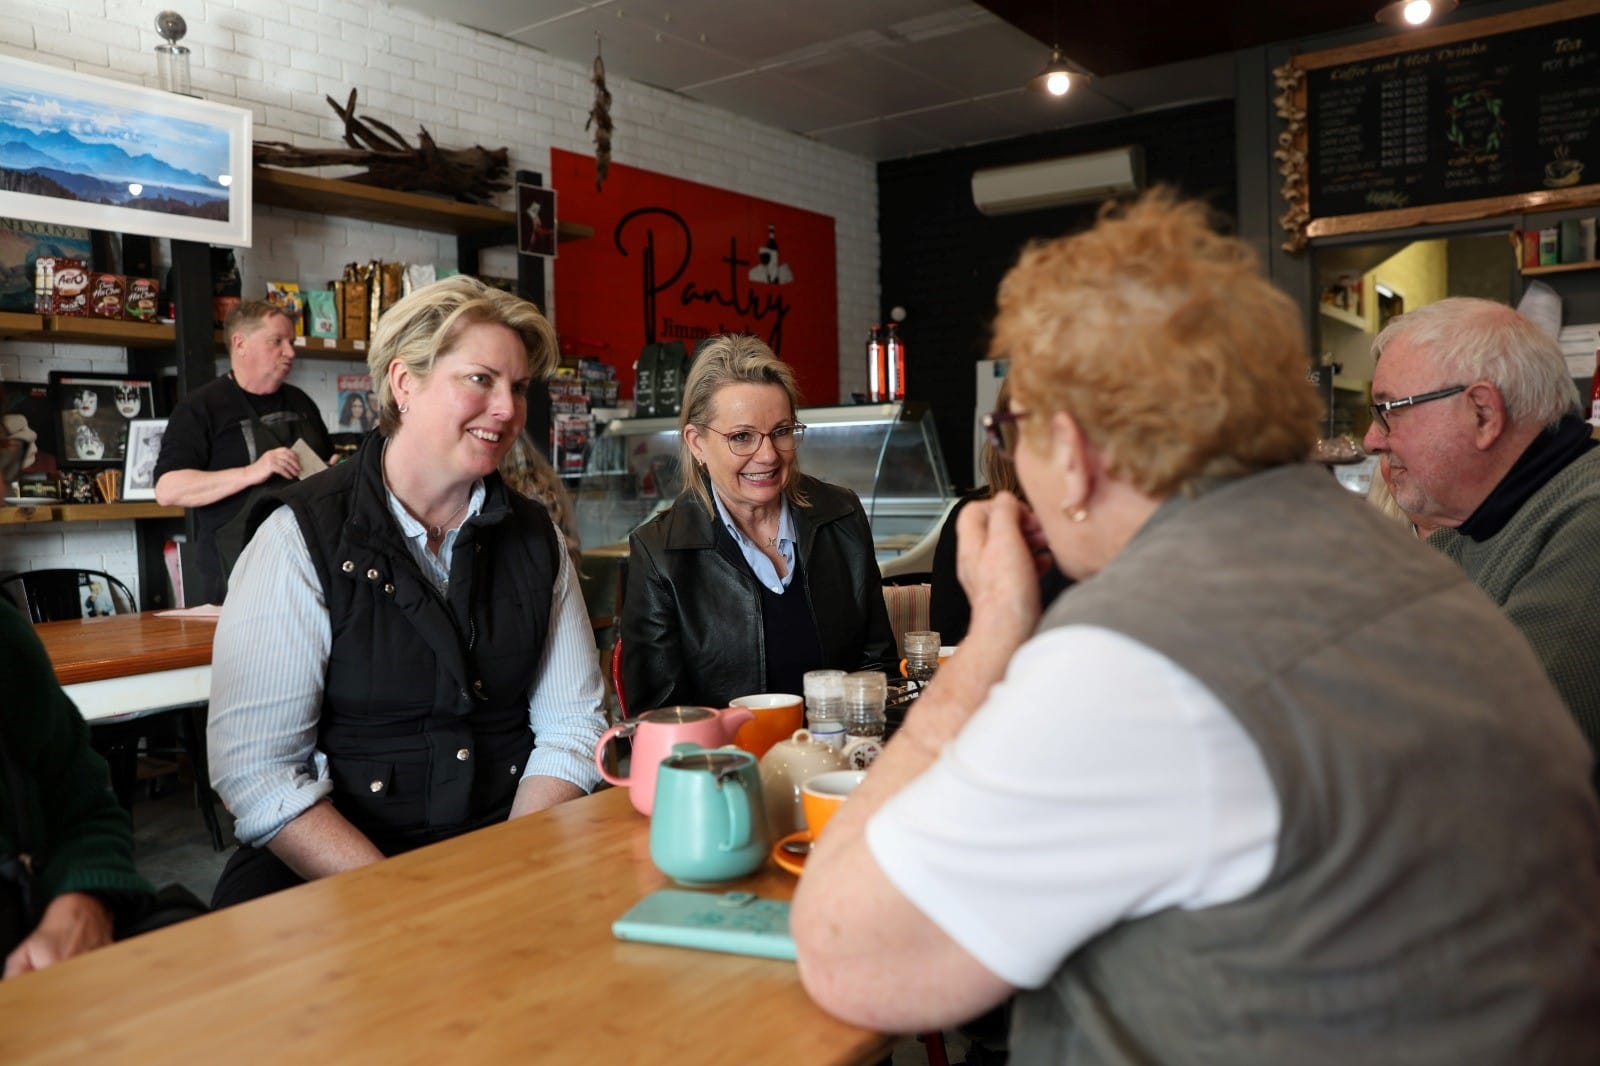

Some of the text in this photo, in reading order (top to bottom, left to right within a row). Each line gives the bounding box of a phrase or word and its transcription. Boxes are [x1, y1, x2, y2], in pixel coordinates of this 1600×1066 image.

[1330, 64, 1369, 81] Coffee
[1371, 57, 1400, 73] and
[1403, 53, 1432, 67] Hot
[1436, 43, 1488, 62] Drinks
[1552, 38, 1584, 53] Tea
[614, 206, 790, 355] Pantry
